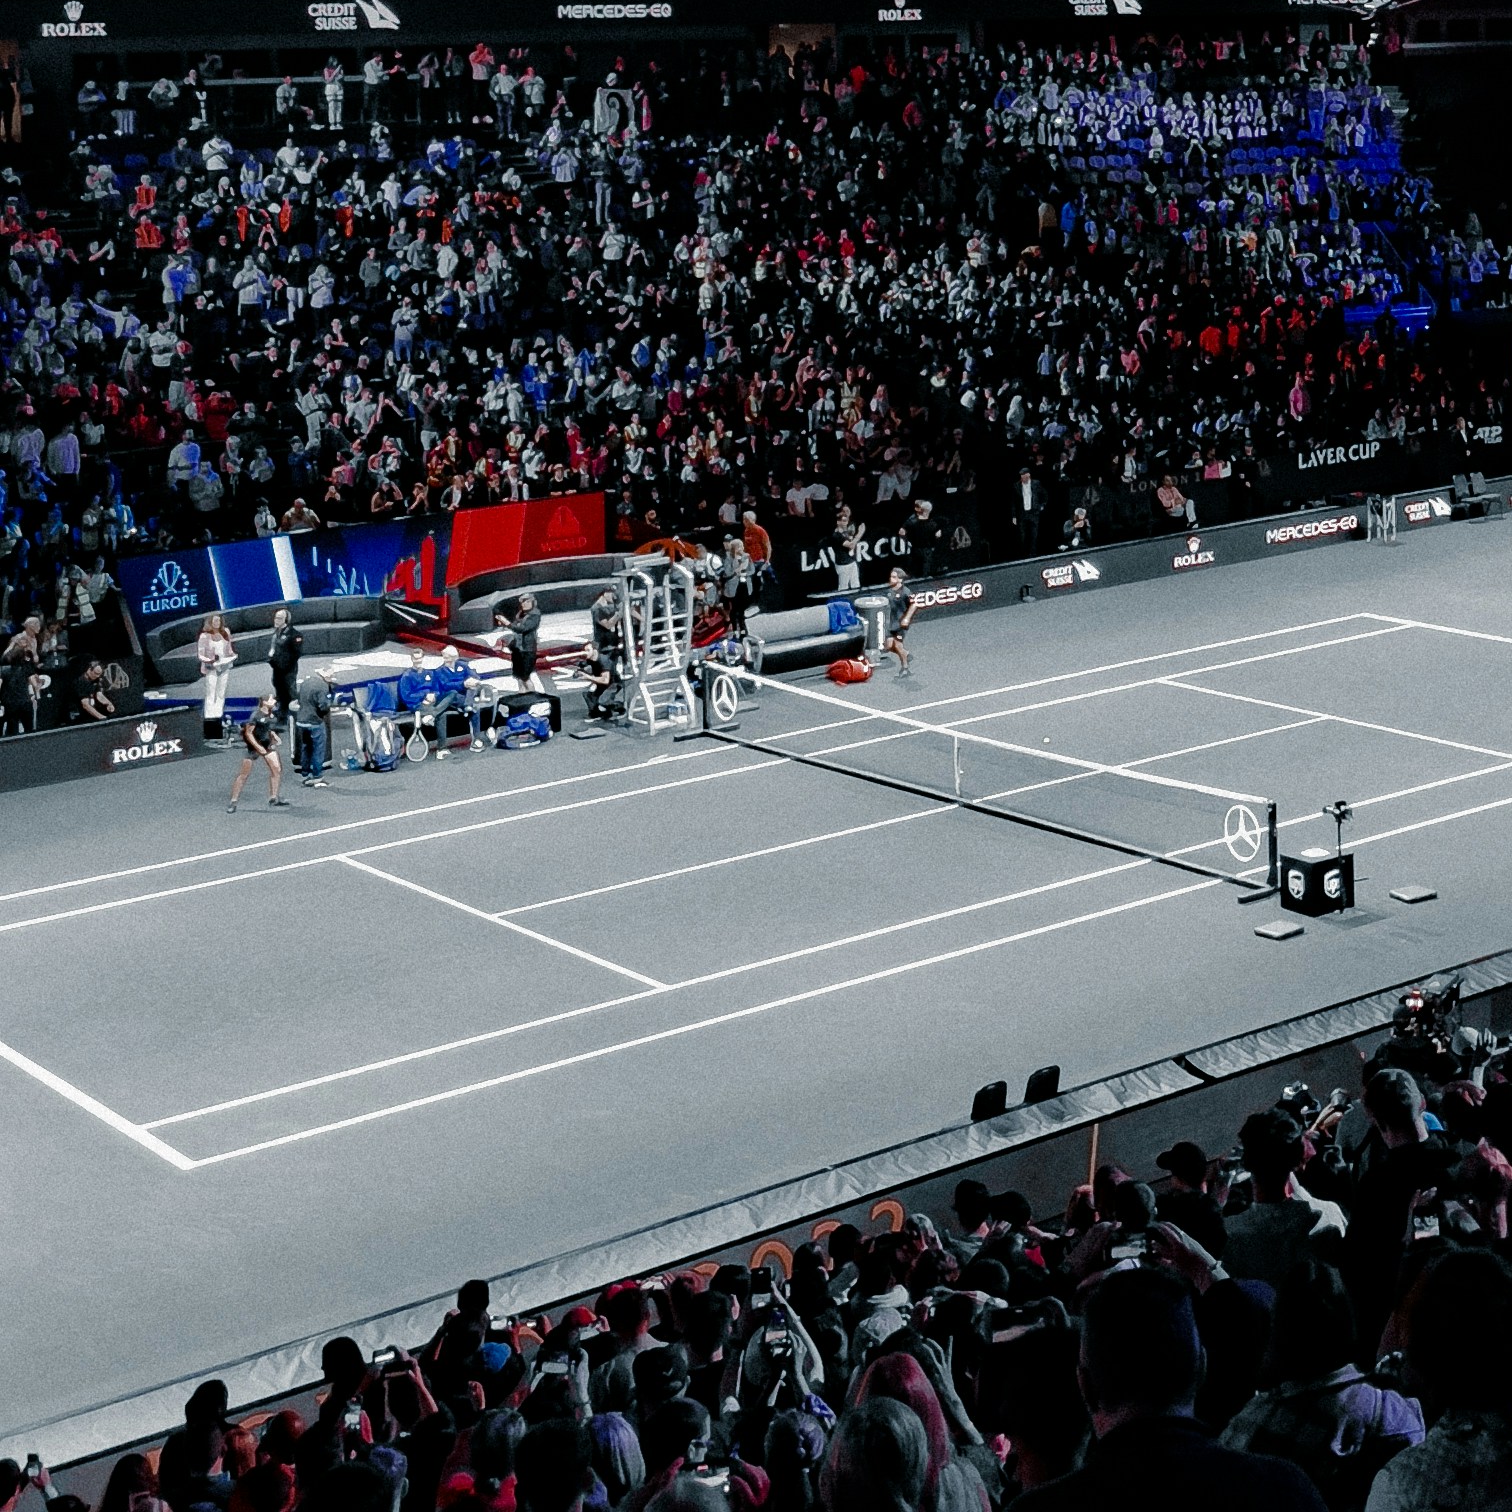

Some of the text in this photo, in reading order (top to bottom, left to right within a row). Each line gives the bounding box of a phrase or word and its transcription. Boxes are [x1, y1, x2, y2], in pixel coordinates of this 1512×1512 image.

[307, 2, 357, 17] CREDIT
[556, 3, 672, 20] MERCEDES-EQ
[878, 8, 923, 22] ROLEX
[1073, 4, 1109, 16] SUISSE
[41, 22, 108, 38] ROLEX
[314, 16, 358, 31] SUISSE
[1298, 441, 1380, 470] LAVER CUP
[1265, 515, 1359, 544] MERCEDES-EQ
[1173, 551, 1215, 568] ROLEX
[142, 594, 198, 614] EUROPE
[112, 739, 183, 764] ROLEX
